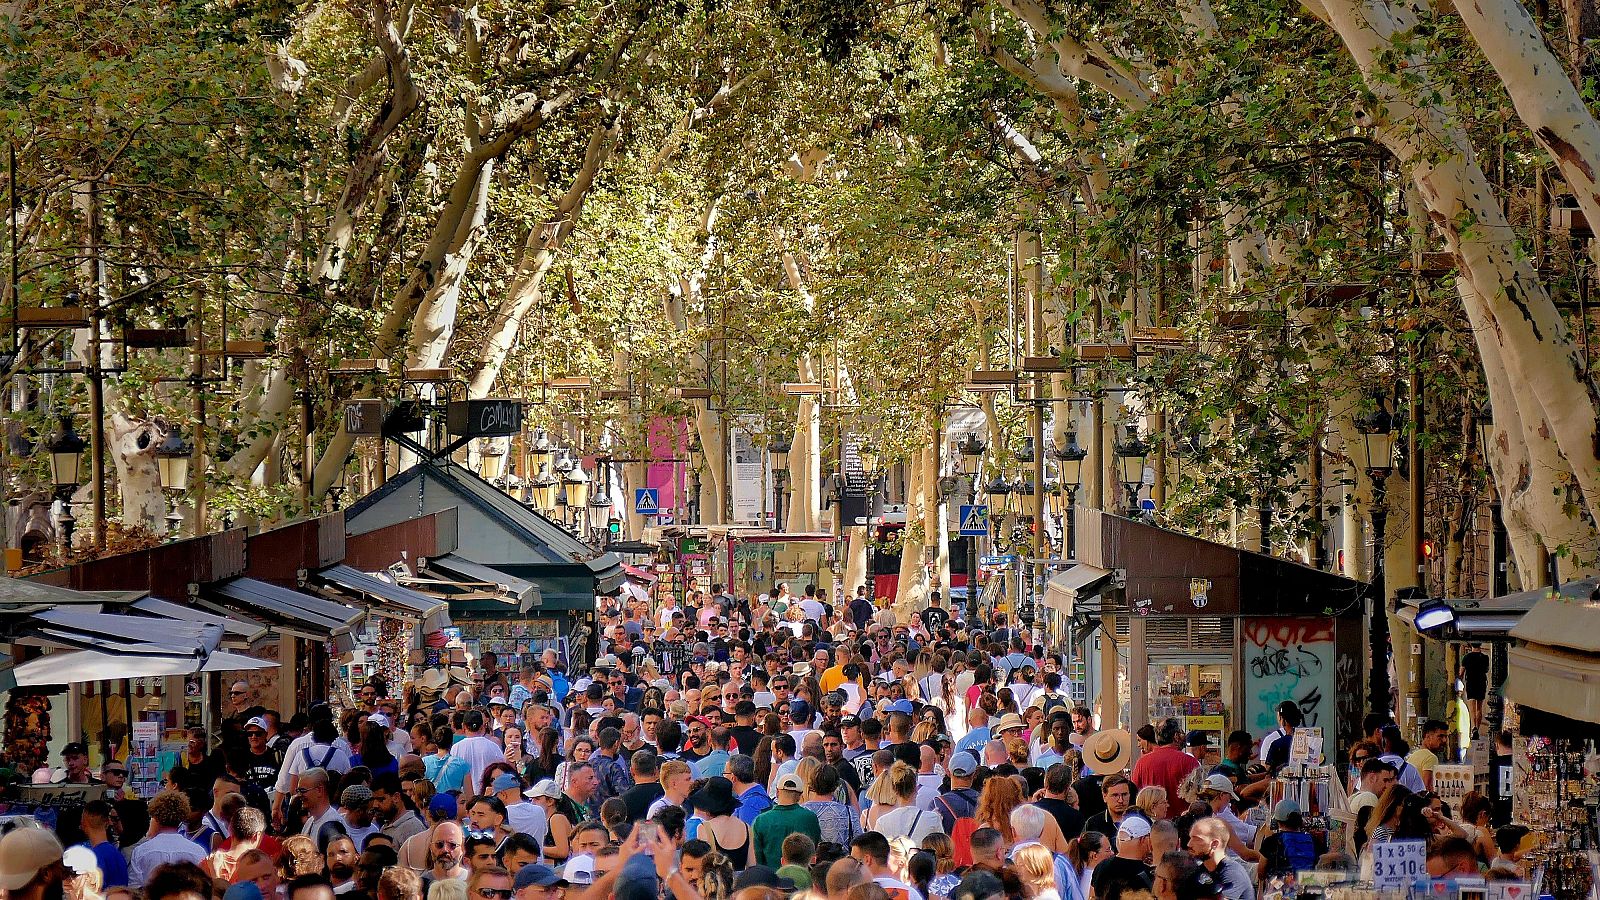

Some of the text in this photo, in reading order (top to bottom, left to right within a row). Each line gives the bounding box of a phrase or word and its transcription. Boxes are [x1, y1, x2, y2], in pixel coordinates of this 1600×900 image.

[1376, 845, 1383, 859] 1
[1387, 848, 1395, 858] x
[1374, 861, 1384, 876] 3
[1388, 864, 1397, 876] x
[1400, 860, 1417, 876] 10
